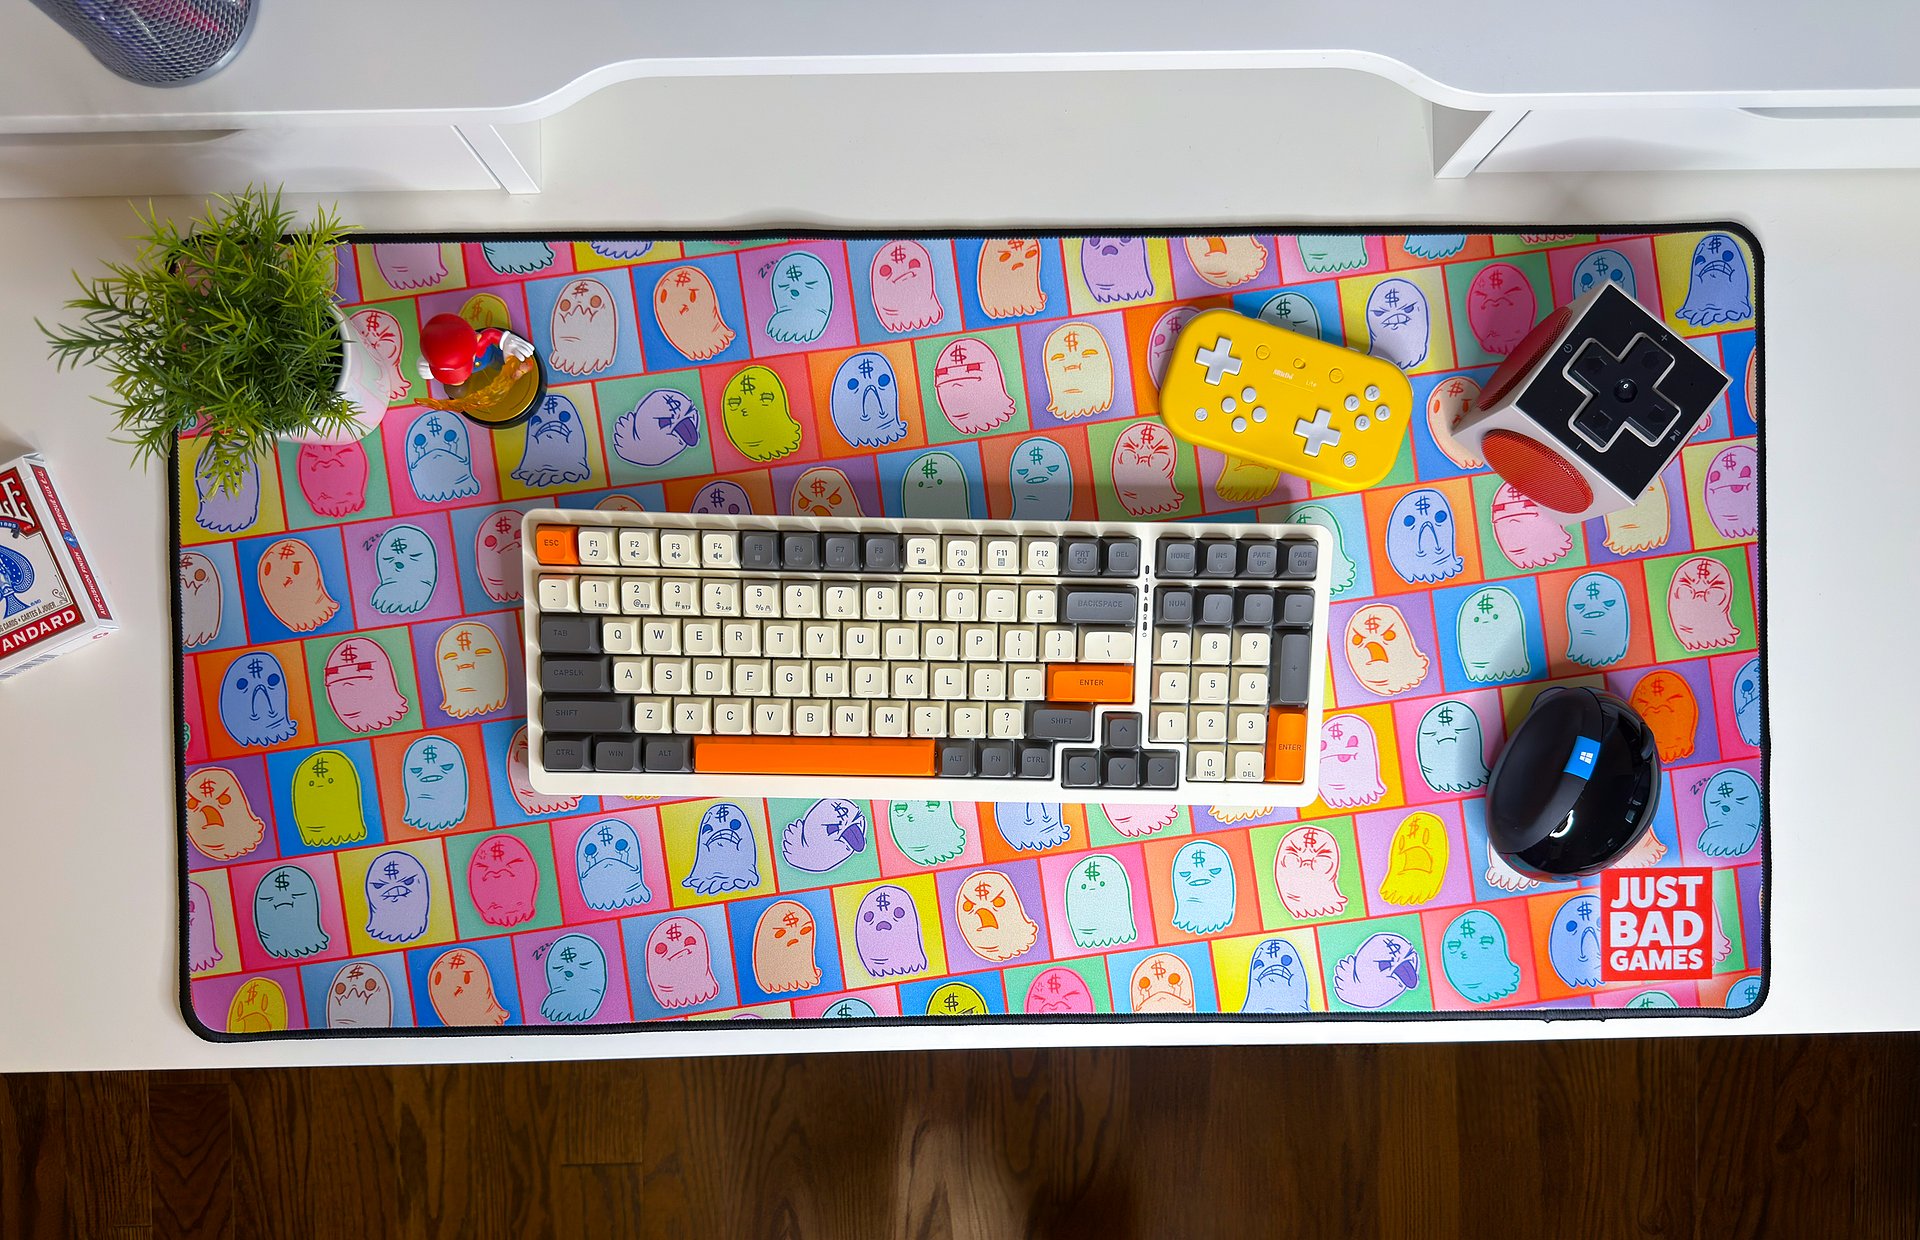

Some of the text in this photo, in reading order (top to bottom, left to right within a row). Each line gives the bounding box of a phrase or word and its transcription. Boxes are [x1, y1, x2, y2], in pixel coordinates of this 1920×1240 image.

[1369, 388, 1377, 397] X
[1350, 399, 1356, 407] Y
[1379, 409, 1386, 417] A
[1360, 419, 1366, 427] B
[544, 539, 559, 547] ESC
[74, 551, 88, 575] FINISH
[1078, 600, 1123, 608] BACKSPACE
[20, 610, 39, 622] CARTES
[42, 602, 57, 613] JOUER
[2, 610, 76, 652] ANDARD
[614, 630, 622, 640] Q
[654, 630, 664, 639] W
[696, 631, 703, 640] E
[736, 632, 743, 641] R
[777, 633, 784, 642] T
[817, 634, 824, 643] Y
[857, 635, 864, 644] U
[937, 636, 944, 645] O
[976, 637, 983, 645] P
[1172, 640, 1178, 649] 7
[1212, 641, 1218, 649] 8
[1253, 641, 1258, 649] 9
[625, 670, 633, 679] A
[666, 670, 672, 680] S
[706, 671, 713, 680] D
[747, 672, 753, 681] F
[786, 673, 793, 682] G
[826, 673, 833, 682] H
[866, 674, 872, 683] J
[906, 675, 914, 684] K
[946, 676, 952, 685] L
[1170, 680, 1176, 688] 4
[1210, 680, 1216, 688] 5
[1250, 681, 1256, 689] 6
[646, 710, 653, 719] Z
[686, 711, 694, 720] X
[727, 711, 733, 720] C
[767, 712, 774, 721] V
[807, 713, 814, 722] B
[846, 713, 854, 722] N
[885, 714, 894, 723] M
[1208, 719, 1214, 727] 2
[1248, 721, 1254, 729] 3
[1610, 876, 1704, 909] JUST
[1610, 910, 1704, 948] BAD
[1610, 949, 1704, 972] GAMES
